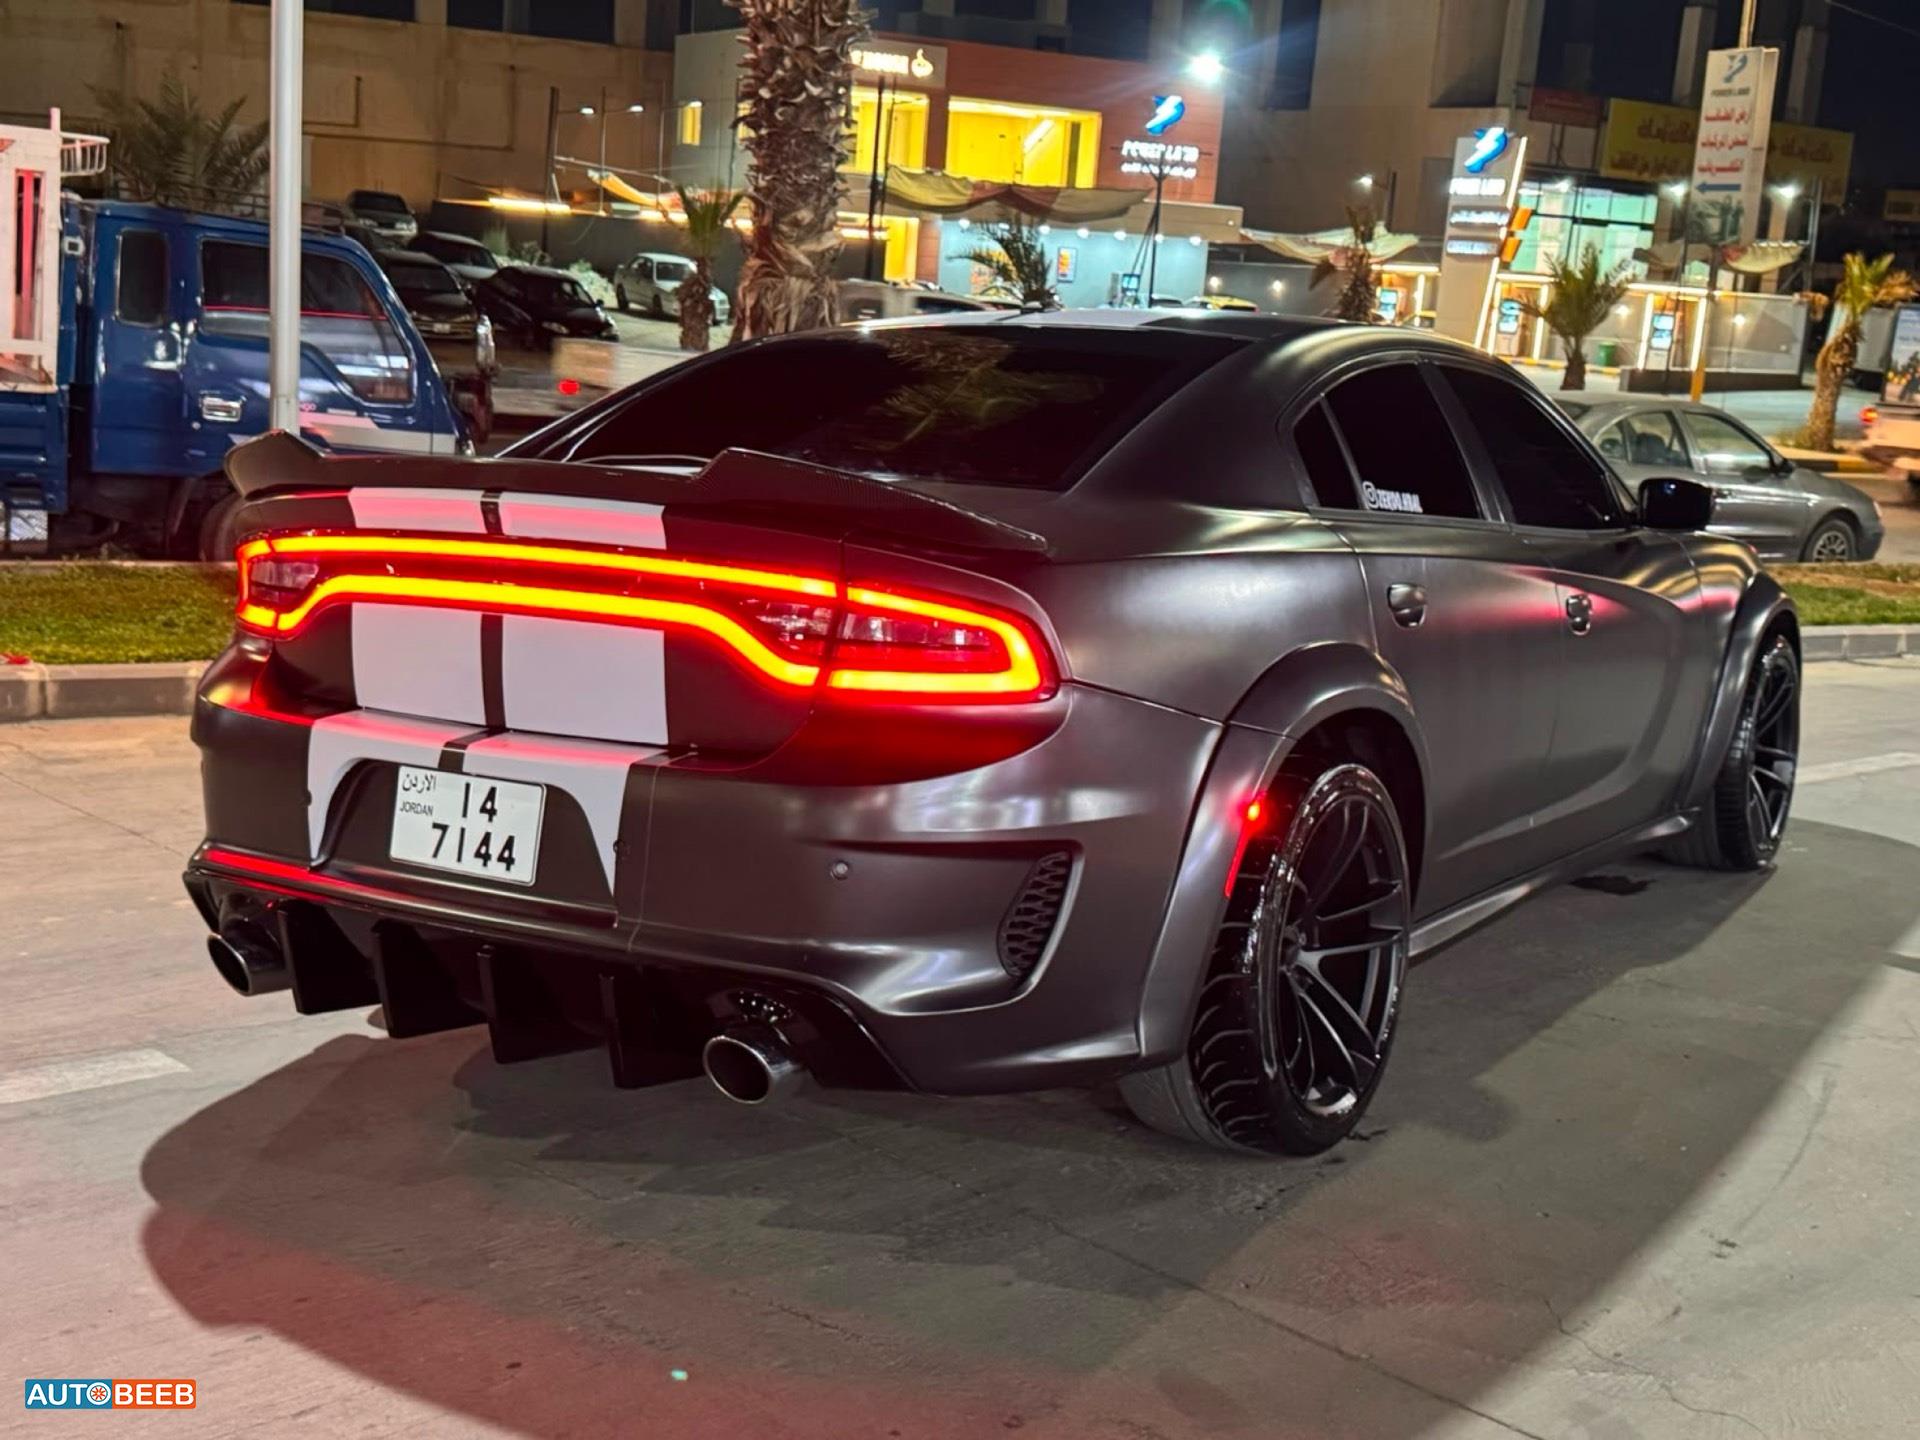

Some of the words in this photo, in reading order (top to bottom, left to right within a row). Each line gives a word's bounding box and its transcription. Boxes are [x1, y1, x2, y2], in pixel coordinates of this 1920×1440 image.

[399, 801, 434, 817] JORDAN
[462, 782, 497, 823] 14
[432, 822, 516, 872] 7144
